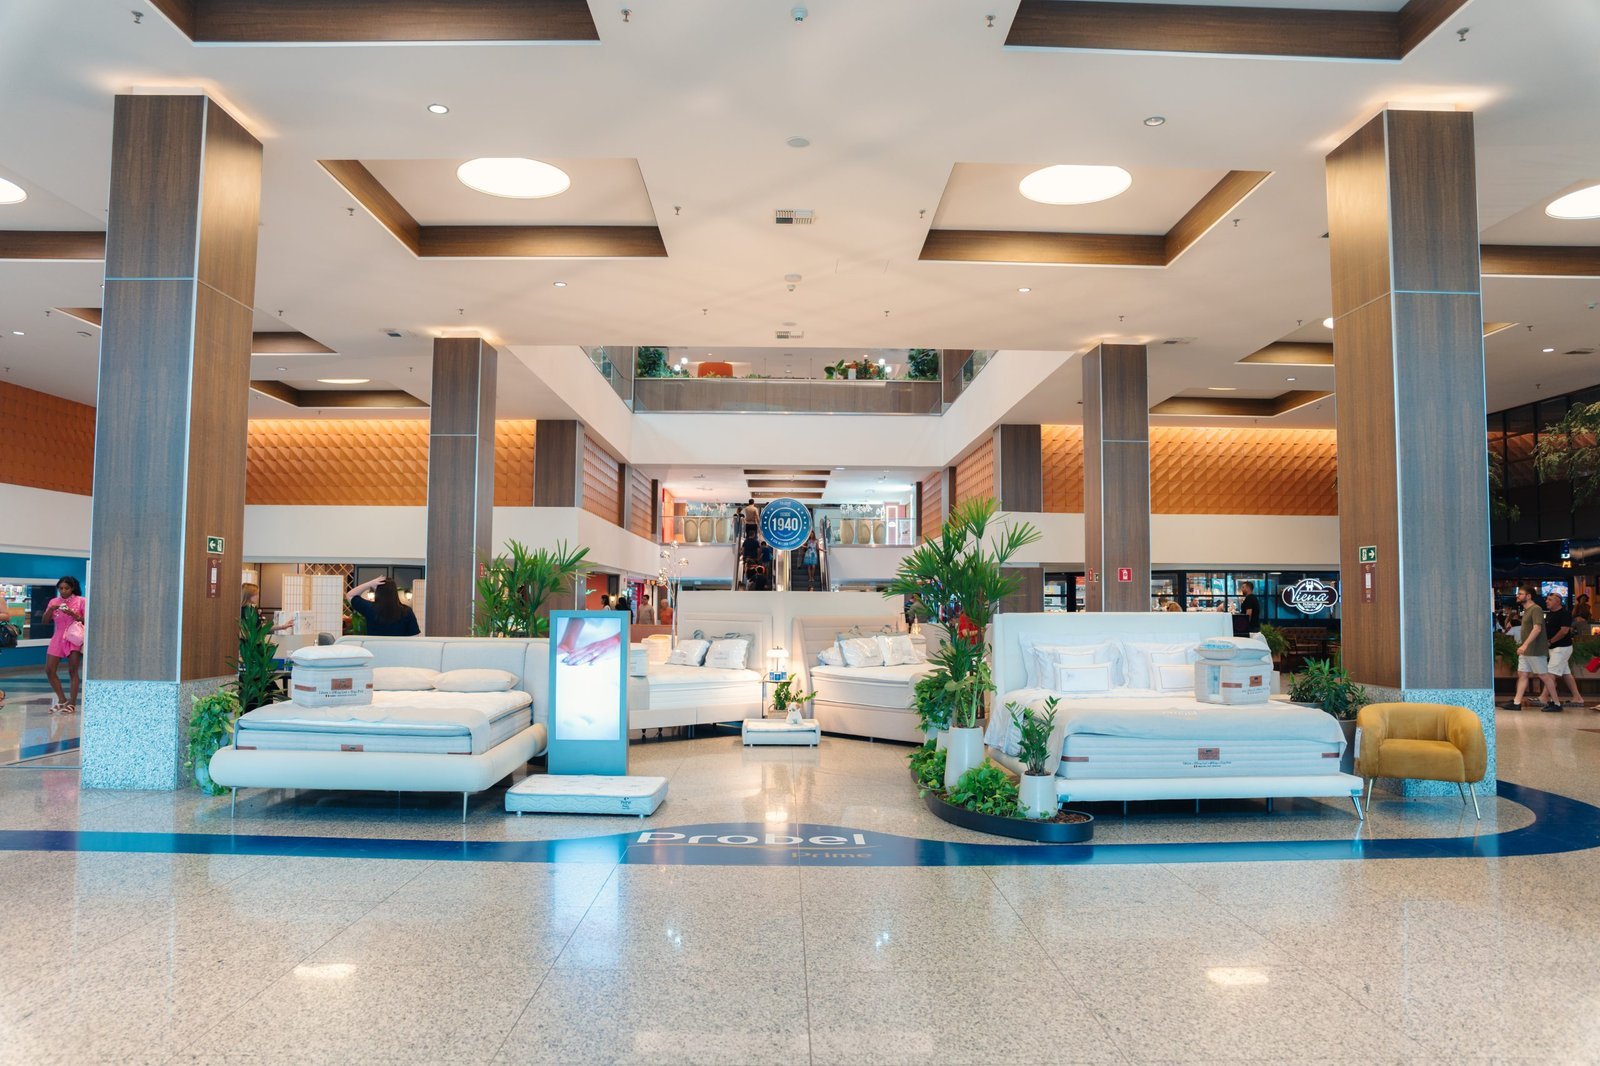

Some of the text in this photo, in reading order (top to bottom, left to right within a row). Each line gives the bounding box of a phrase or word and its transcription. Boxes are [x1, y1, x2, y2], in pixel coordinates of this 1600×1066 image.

[772, 517, 798, 531] 1940
[1287, 586, 1329, 602] Viena
[637, 832, 866, 845] Probel
